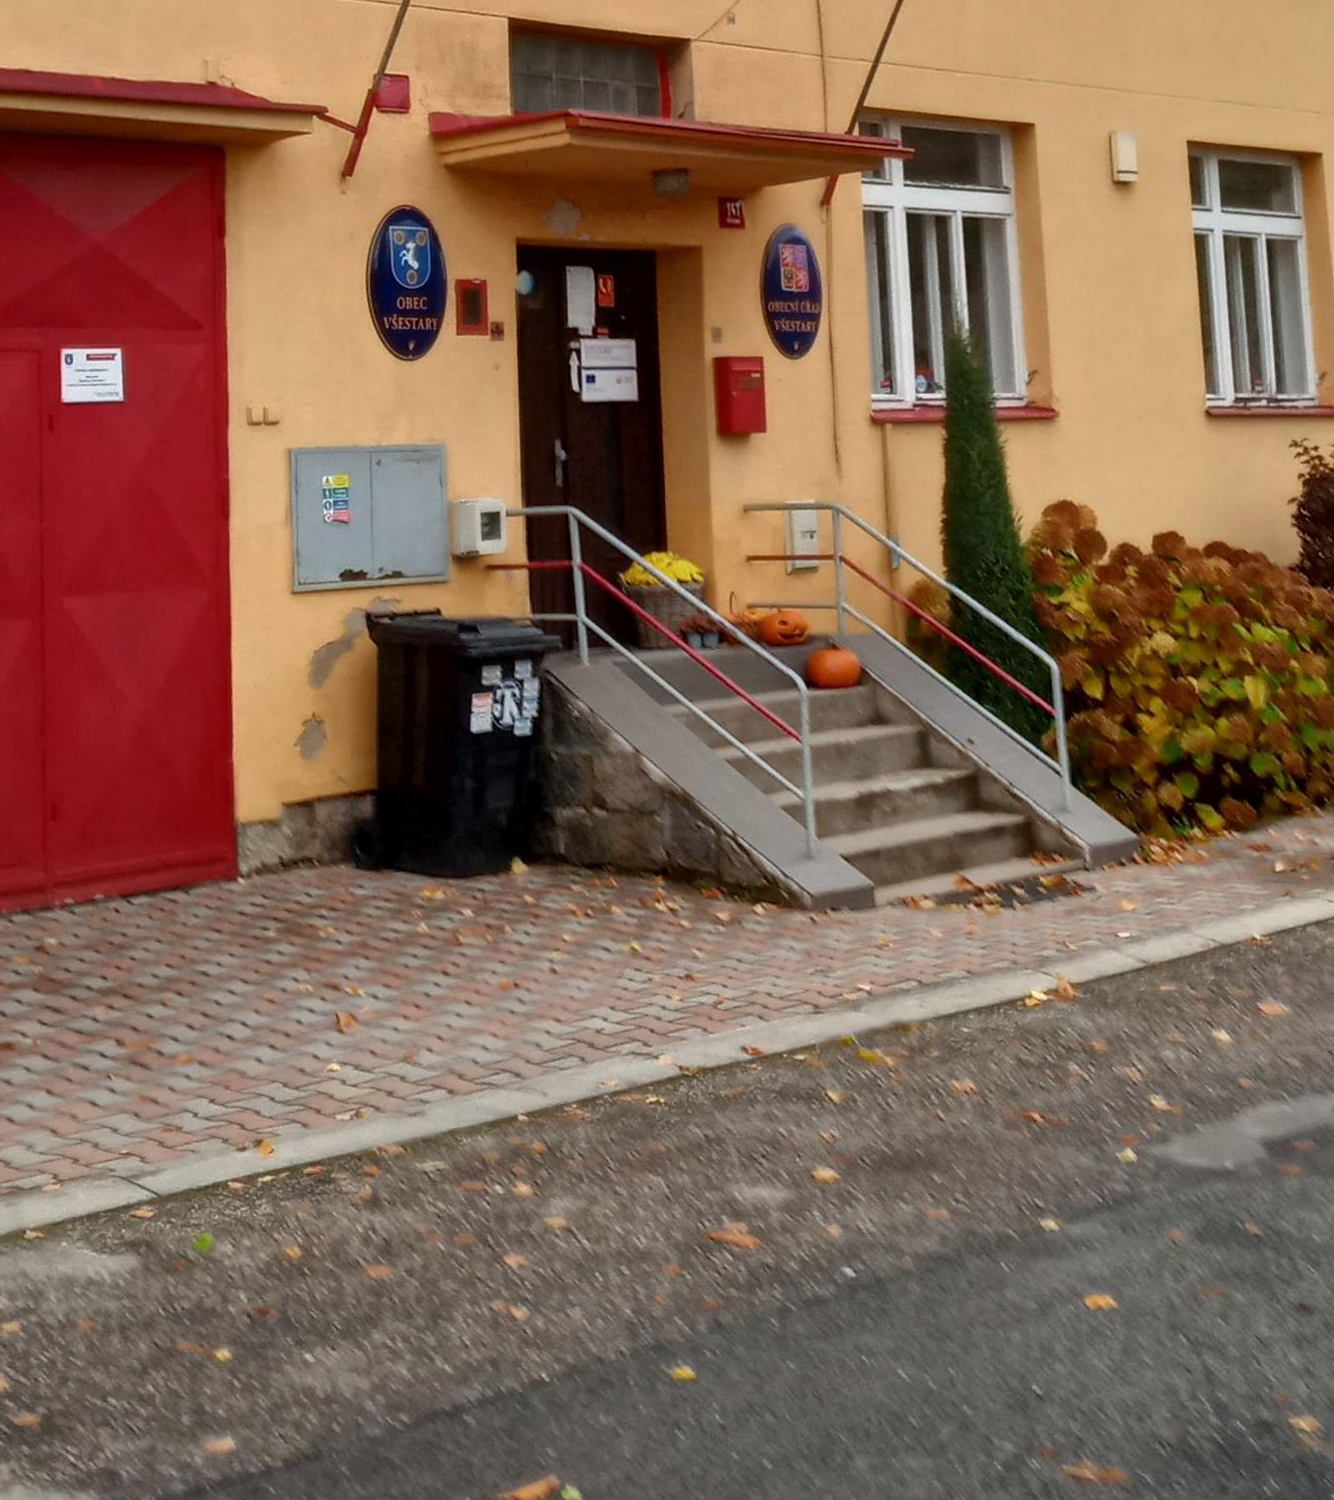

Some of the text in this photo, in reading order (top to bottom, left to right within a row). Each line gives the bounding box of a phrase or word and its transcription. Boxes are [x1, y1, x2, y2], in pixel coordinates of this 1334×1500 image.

[396, 296, 427, 310] OBEC
[383, 313, 439, 331] VŠESTARY
[773, 318, 816, 333] VŠESTARY
